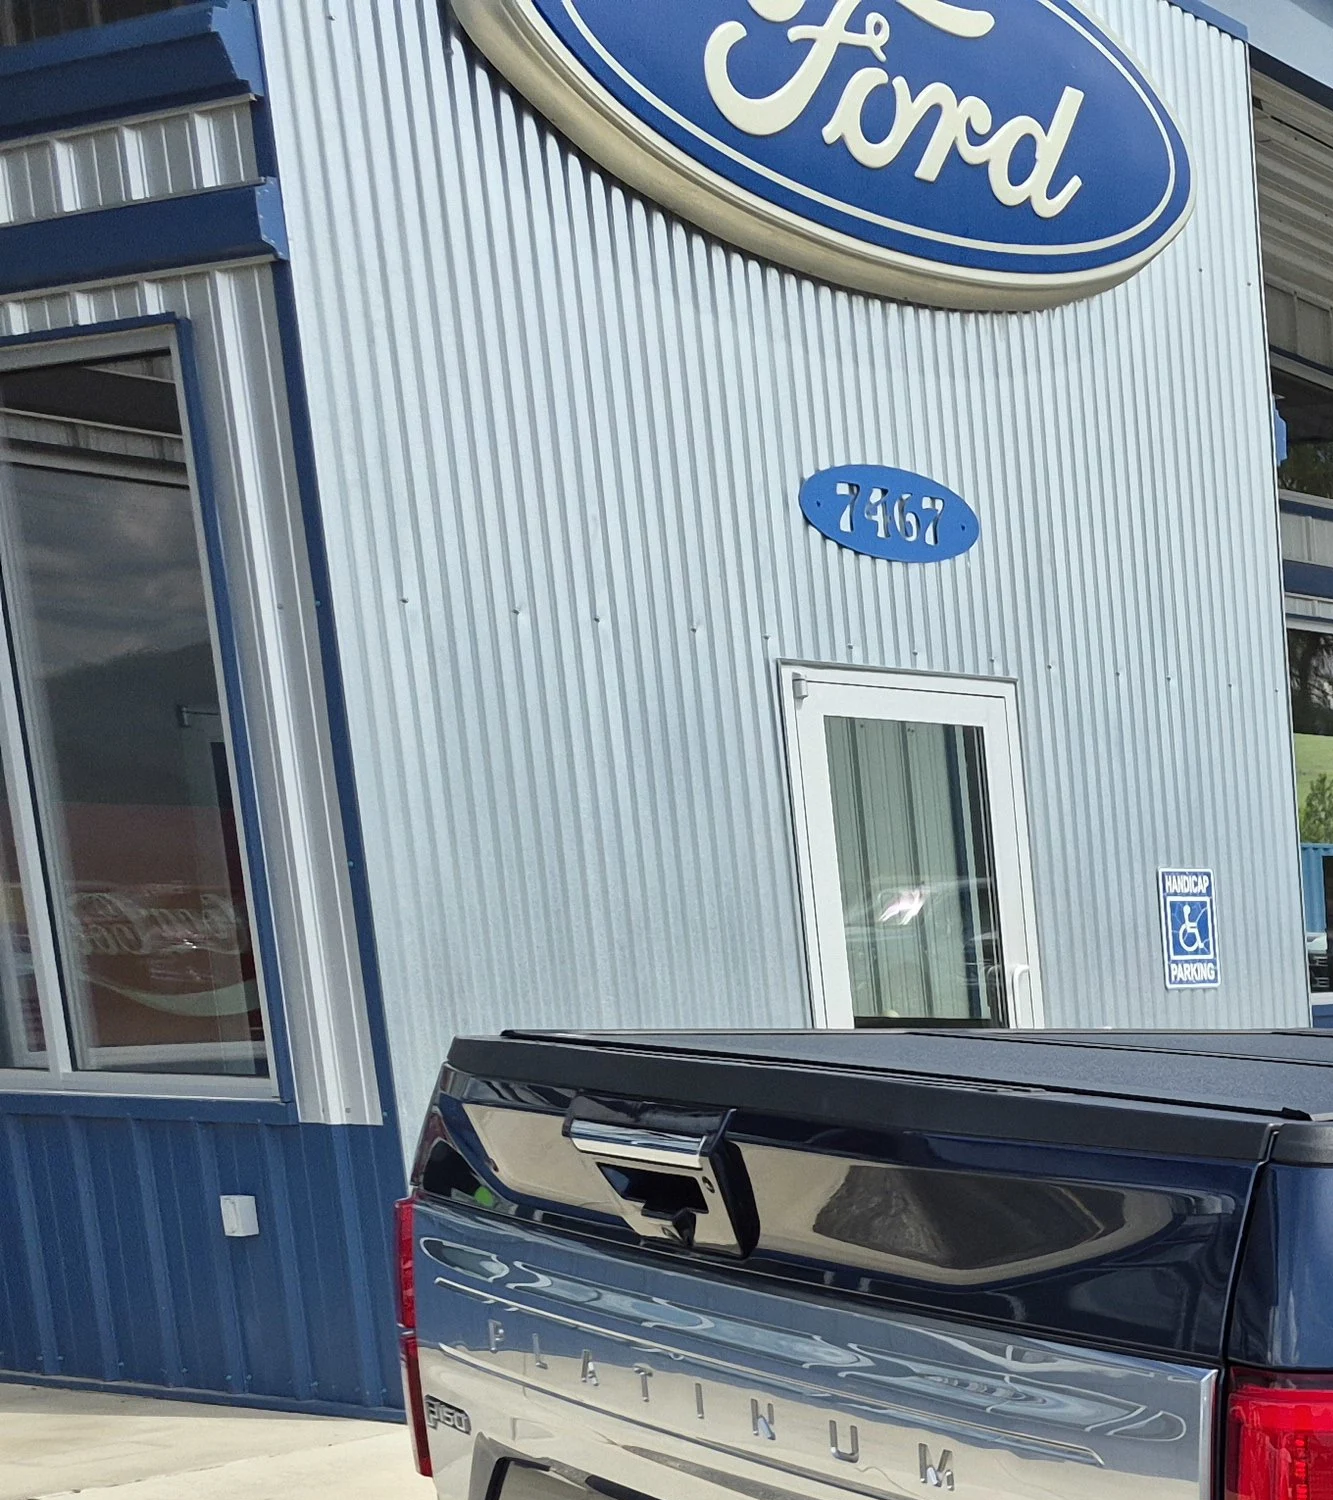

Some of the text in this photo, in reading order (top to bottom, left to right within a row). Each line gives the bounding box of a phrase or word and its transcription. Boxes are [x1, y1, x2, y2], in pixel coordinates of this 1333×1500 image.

[704, 0, 1083, 219] Ford
[836, 481, 945, 546] 7467
[1165, 874, 1210, 893] HANDICAP
[1170, 962, 1216, 982] PARKING
[488, 1319, 956, 1491] PLATINUM
